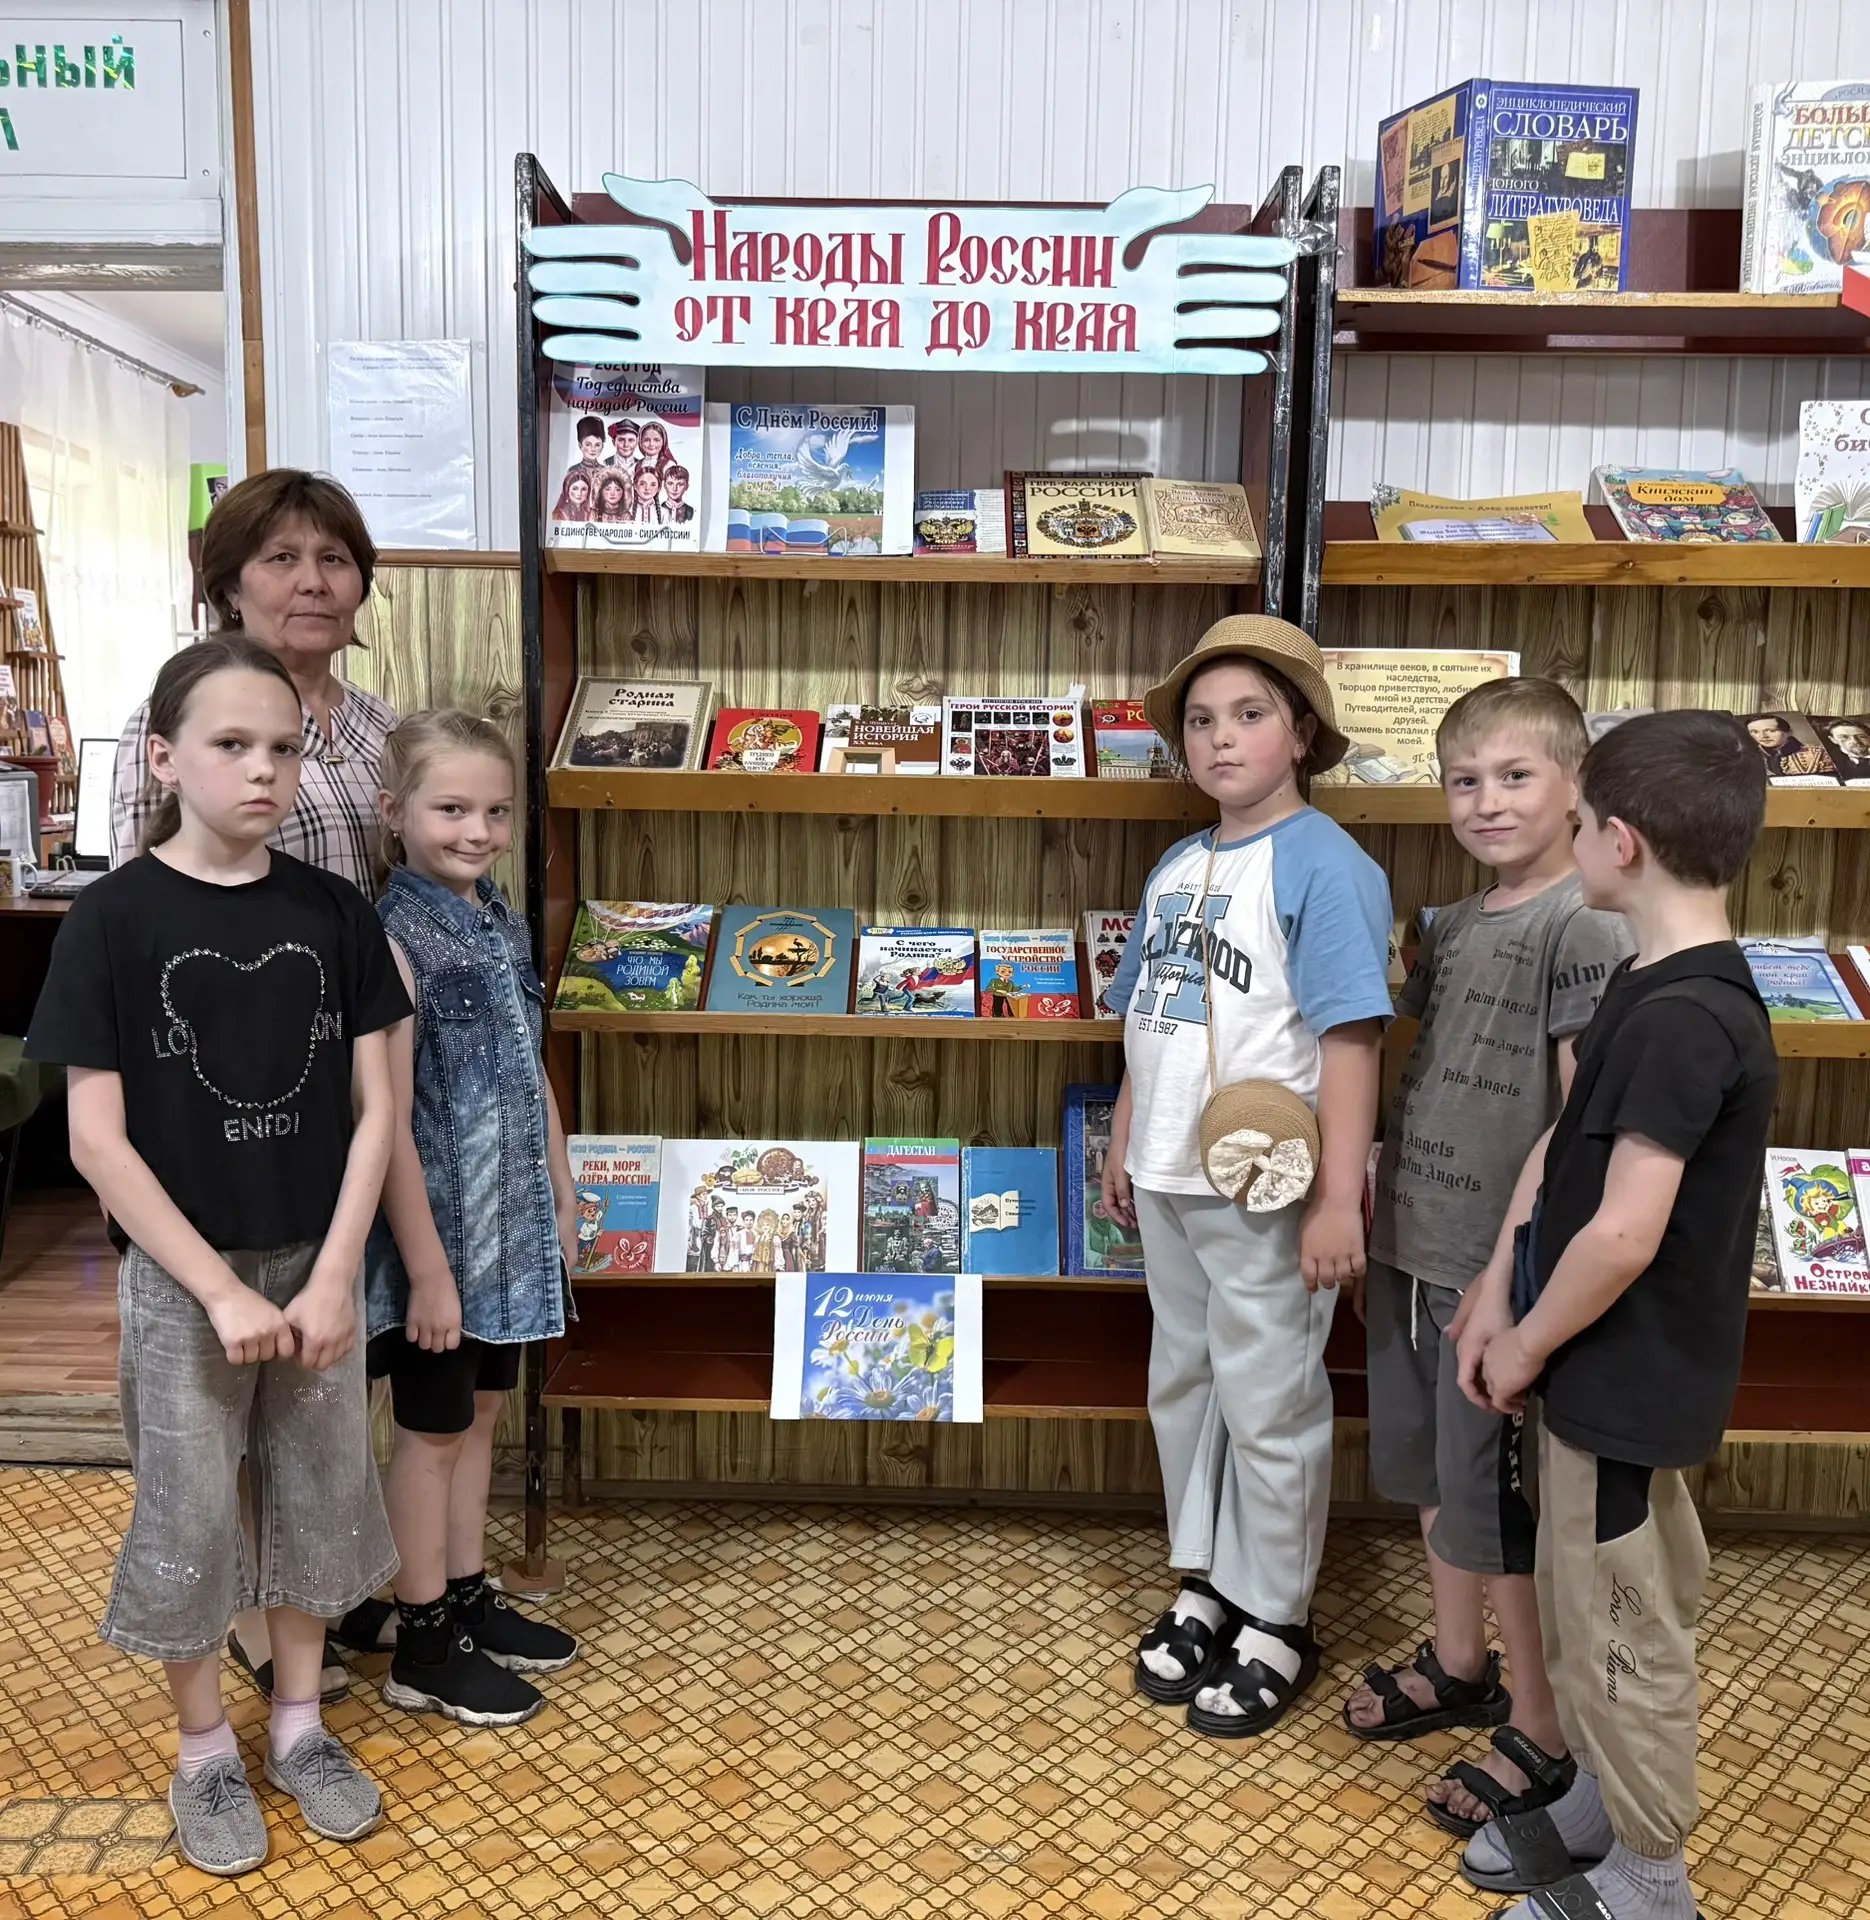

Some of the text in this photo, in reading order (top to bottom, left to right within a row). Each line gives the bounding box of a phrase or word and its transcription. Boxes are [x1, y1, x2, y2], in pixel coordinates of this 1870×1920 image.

[1496, 96, 1627, 115] ЭНЦИКЛОПЕДИЧЕСКИЙ
[1493, 111, 1628, 142] СЛОВАРЬ
[1490, 177, 1539, 191] ЮНОГО
[1488, 193, 1619, 224] ЛИТЕРАТУРОВЕДА
[577, 376, 681, 397] Год единства
[567, 397, 689, 416] народов России
[736, 406, 879, 432] С Днём России!
[1030, 487, 1138, 498] РОССИИ
[554, 527, 560, 536] В
[561, 527, 598, 537] ЕДИНСТВЕ
[599, 528, 633, 538] НАРОДОВ
[639, 529, 659, 539] СИЛА
[1337, 661, 1492, 673] В хранилище веков, в святыне их
[1386, 674, 1441, 684] наследства,
[614, 688, 675, 700] Родная
[1338, 683, 1377, 693] Творцов
[1378, 684, 1441, 695] приветствую,
[608, 698, 675, 709] старина
[1374, 694, 1451, 706] мной из детства,
[983, 703, 1026, 711] РУССКОЙ
[1344, 703, 1418, 714] Путеводителей,
[1393, 715, 1429, 726] друзей.
[854, 723, 934, 734] НОВЕЙШАЯ
[1342, 725, 1430, 736] пламень воспалил
[853, 732, 919, 741] ИСТОРИЯ
[1397, 737, 1425, 746] моей.
[890, 951, 941, 959] Родина?
[986, 945, 1066, 954] ГОСУДАРСТВЕННОЕ
[627, 956, 663, 965] ЧТО МЫ
[1001, 954, 1064, 963] УСТРОЙСТВО
[617, 964, 670, 977] РОДИНОЙ
[1021, 964, 1061, 973] РОССИИ
[737, 993, 757, 1001] Как
[779, 993, 823, 1003] хороша
[746, 1000, 788, 1008] Родина
[1442, 1067, 1522, 1098] Palm Angels
[1406, 1129, 1456, 1158] Angels
[886, 1145, 936, 1157] ДАГЕСТАН
[582, 1160, 641, 1173] РЕКИ, МОРЯ
[579, 1172, 651, 1185] ОЗЁРА РОССИИ
[1425, 1162, 1482, 1192] Angels
[813, 1286, 894, 1317] 12 июня
[851, 1305, 904, 1329] День
[820, 1319, 891, 1343] России
[1609, 1572, 1642, 1628] Loro
[1606, 1638, 1648, 1705] Piana
